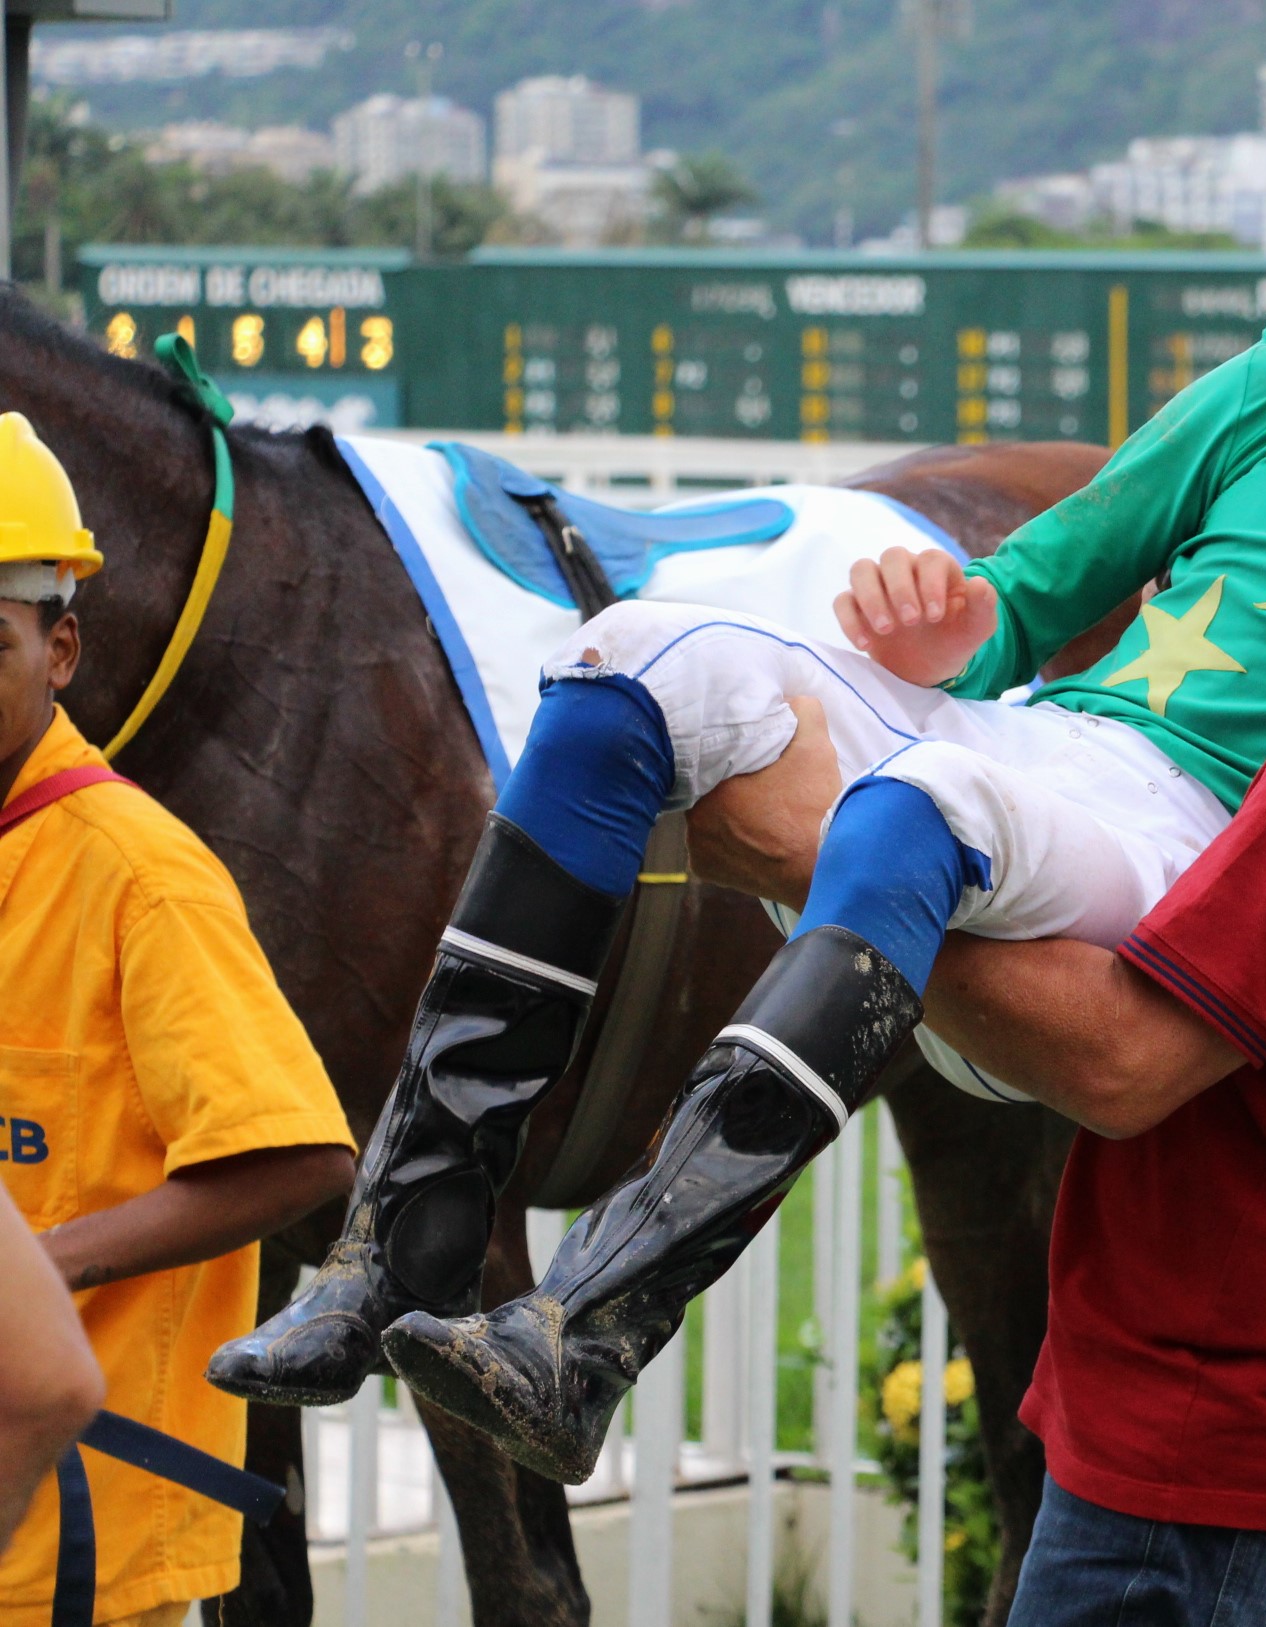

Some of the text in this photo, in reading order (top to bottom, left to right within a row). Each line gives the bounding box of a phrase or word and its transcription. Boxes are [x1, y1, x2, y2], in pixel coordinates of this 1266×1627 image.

[99, 266, 385, 307] ORDEM DE CHEGADA
[786, 275, 926, 316] VENCEDOR
[0, 1115, 49, 1165] B
